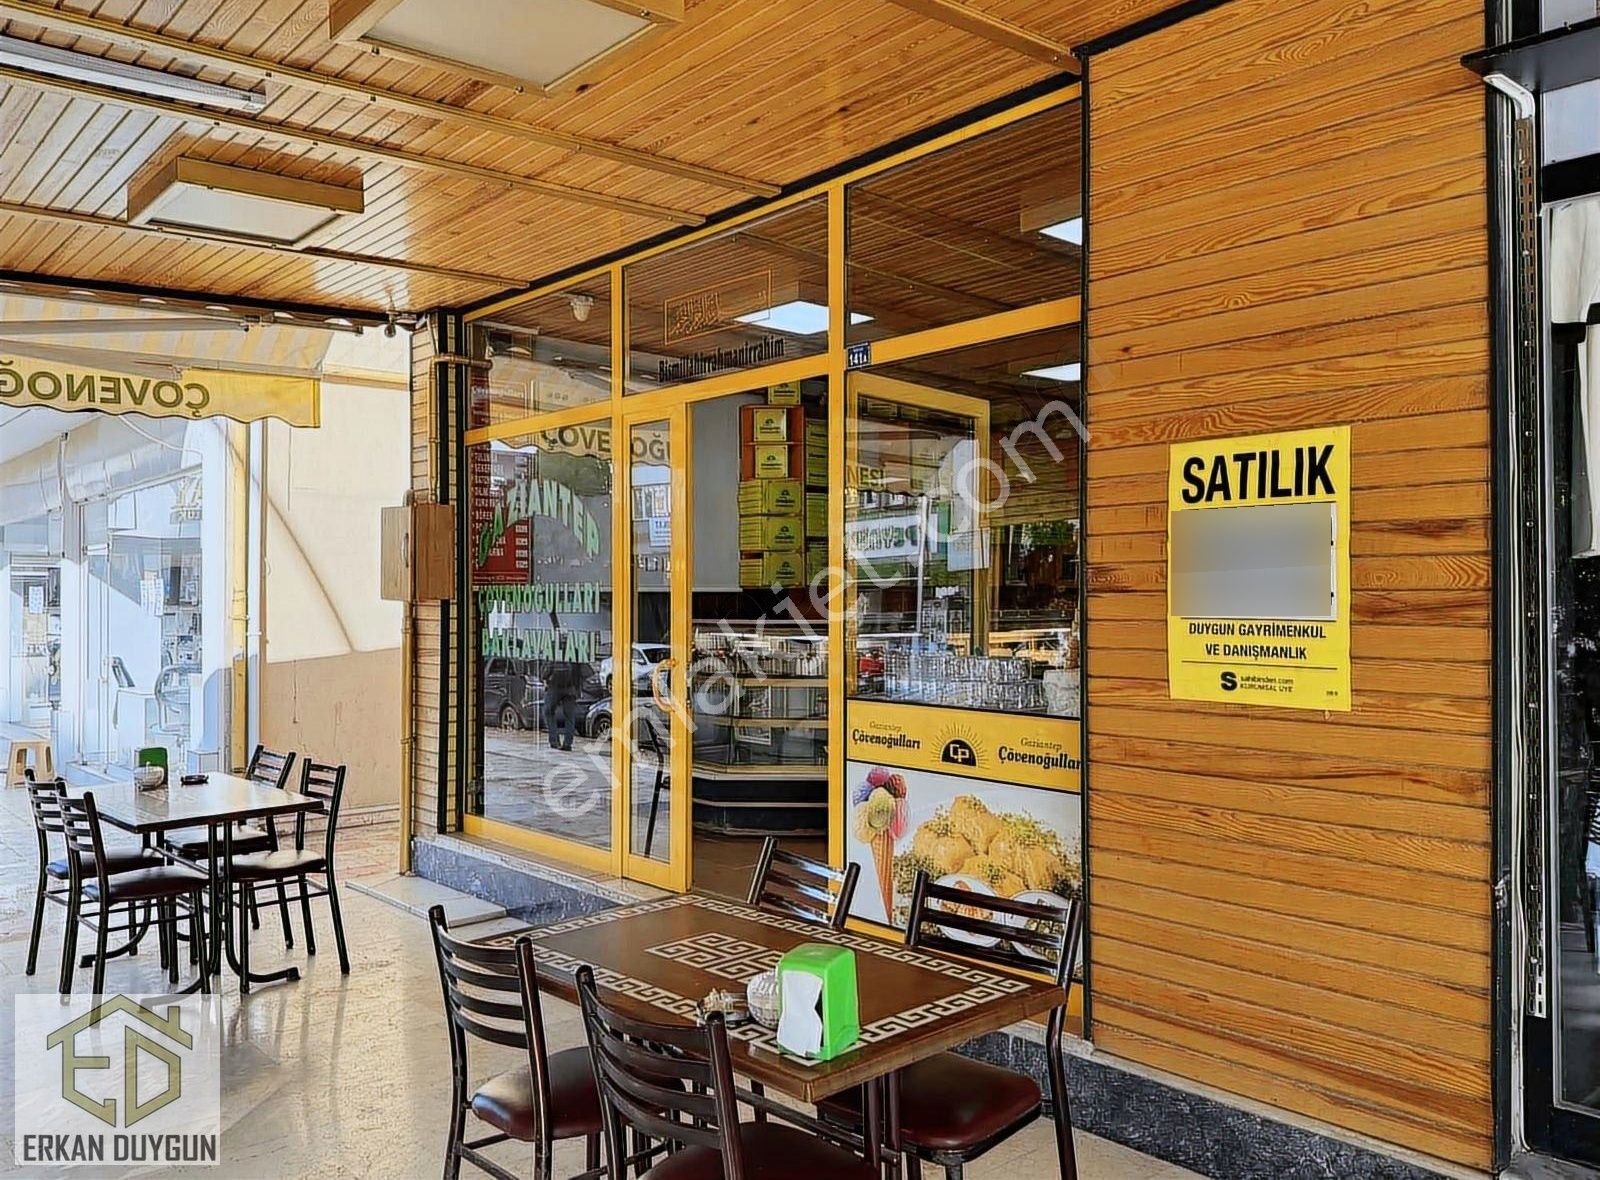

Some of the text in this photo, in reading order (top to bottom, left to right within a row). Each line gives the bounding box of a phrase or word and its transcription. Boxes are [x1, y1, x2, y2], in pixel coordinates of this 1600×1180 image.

[1181, 444, 1336, 504] SATILIK
[1188, 622, 1327, 639] DUYGUN GAYRİMENKUL
[1205, 643, 1307, 660] VE DANIŞMANLIK
[1020, 736, 1063, 753] Gaziantep
[998, 745, 1081, 770] Çövenoğullar
